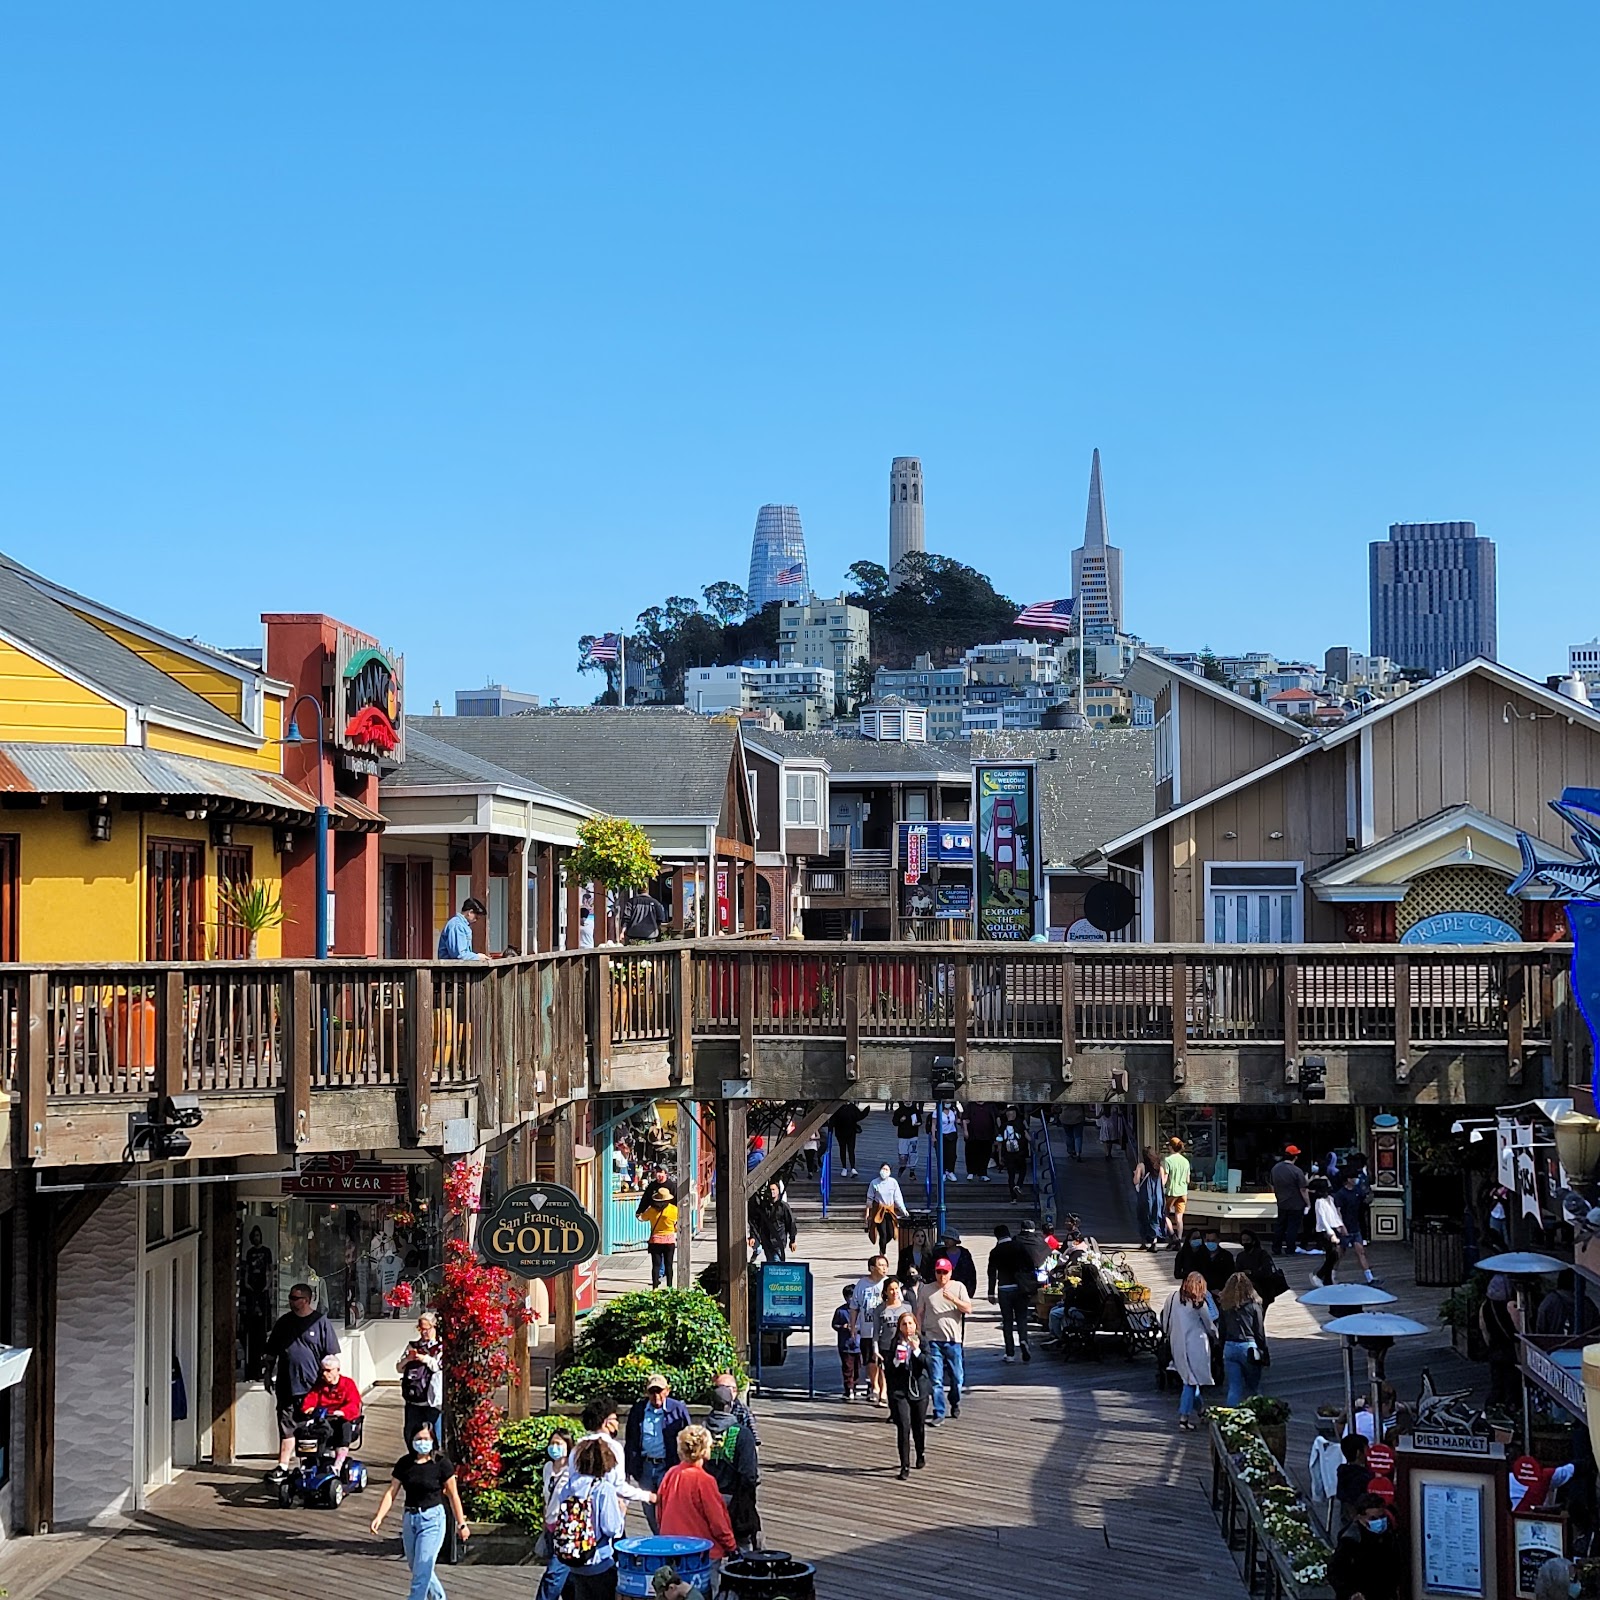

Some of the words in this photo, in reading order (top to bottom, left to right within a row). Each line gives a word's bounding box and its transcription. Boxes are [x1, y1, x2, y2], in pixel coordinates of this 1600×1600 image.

[908, 825, 928, 834] Lids
[910, 835, 918, 877] CUSTOM
[985, 908, 1025, 916] EXPLORE
[991, 931, 1020, 939] STATE
[1406, 917, 1464, 945] CREPE
[332, 1154, 351, 1171] SF
[299, 1176, 335, 1188] CITY
[341, 1177, 381, 1189] WEAR
[499, 1218, 520, 1229] San
[523, 1211, 578, 1230] Francisco
[492, 1227, 585, 1254] GOLD
[792, 1274, 800, 1282] 39
[769, 1283, 784, 1291] Win
[1417, 1436, 1440, 1447] PIER
[1442, 1437, 1485, 1449] MARKET
